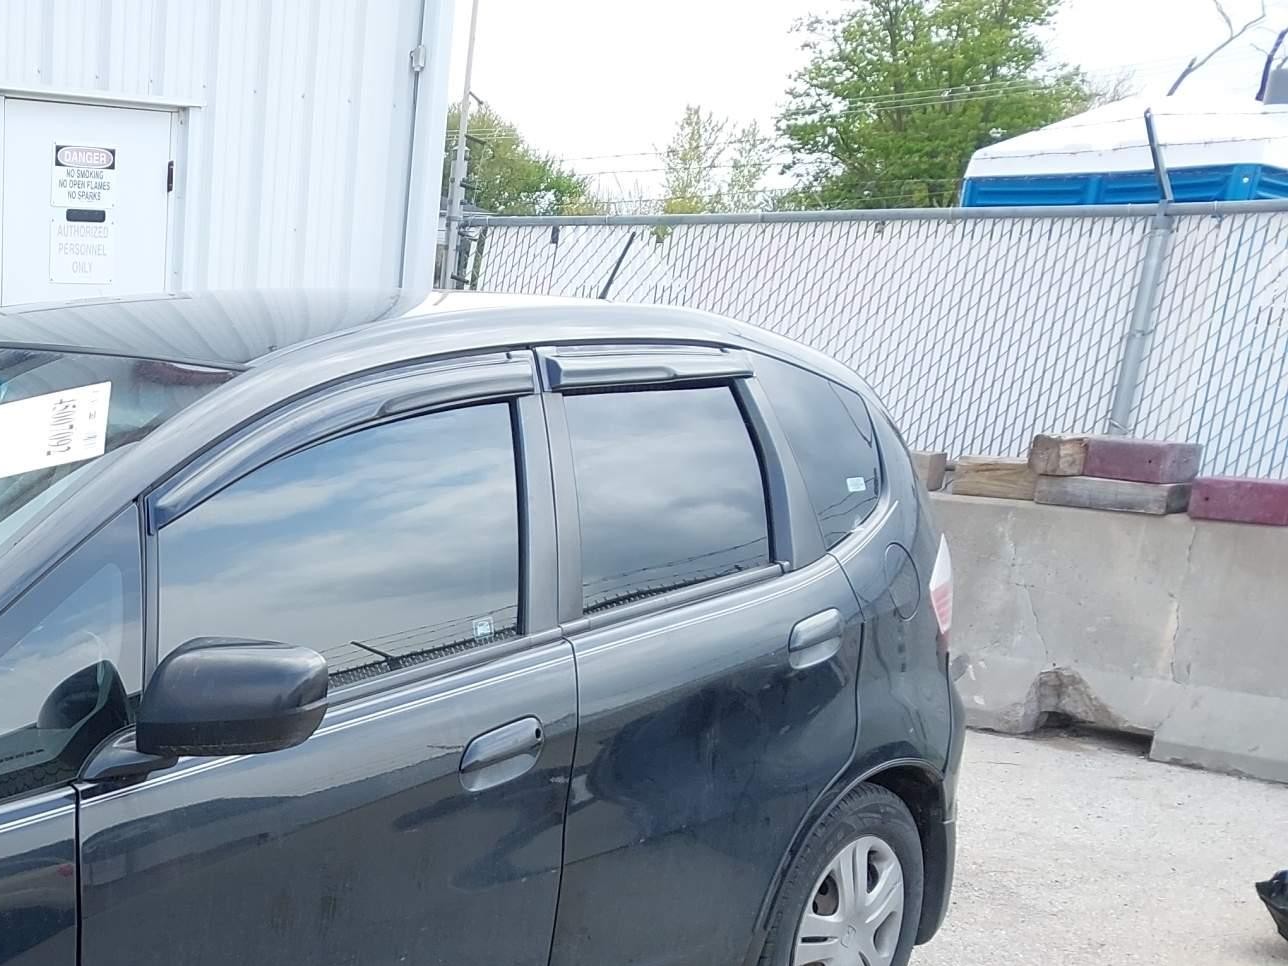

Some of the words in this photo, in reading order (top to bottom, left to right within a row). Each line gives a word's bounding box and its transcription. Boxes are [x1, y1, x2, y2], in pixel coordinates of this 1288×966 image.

[64, 151, 107, 164] DANGER
[66, 169, 75, 178] NO
[76, 169, 104, 180] SMOKING
[58, 179, 68, 189] NO
[69, 179, 86, 190] OPEN
[87, 180, 111, 191] FLAMES
[67, 191, 77, 200] NO
[78, 191, 101, 201] SPARKS
[57, 224, 109, 239] AUTHORIZED
[58, 242, 108, 256] PERSONNEL
[72, 261, 94, 273] ONLY
